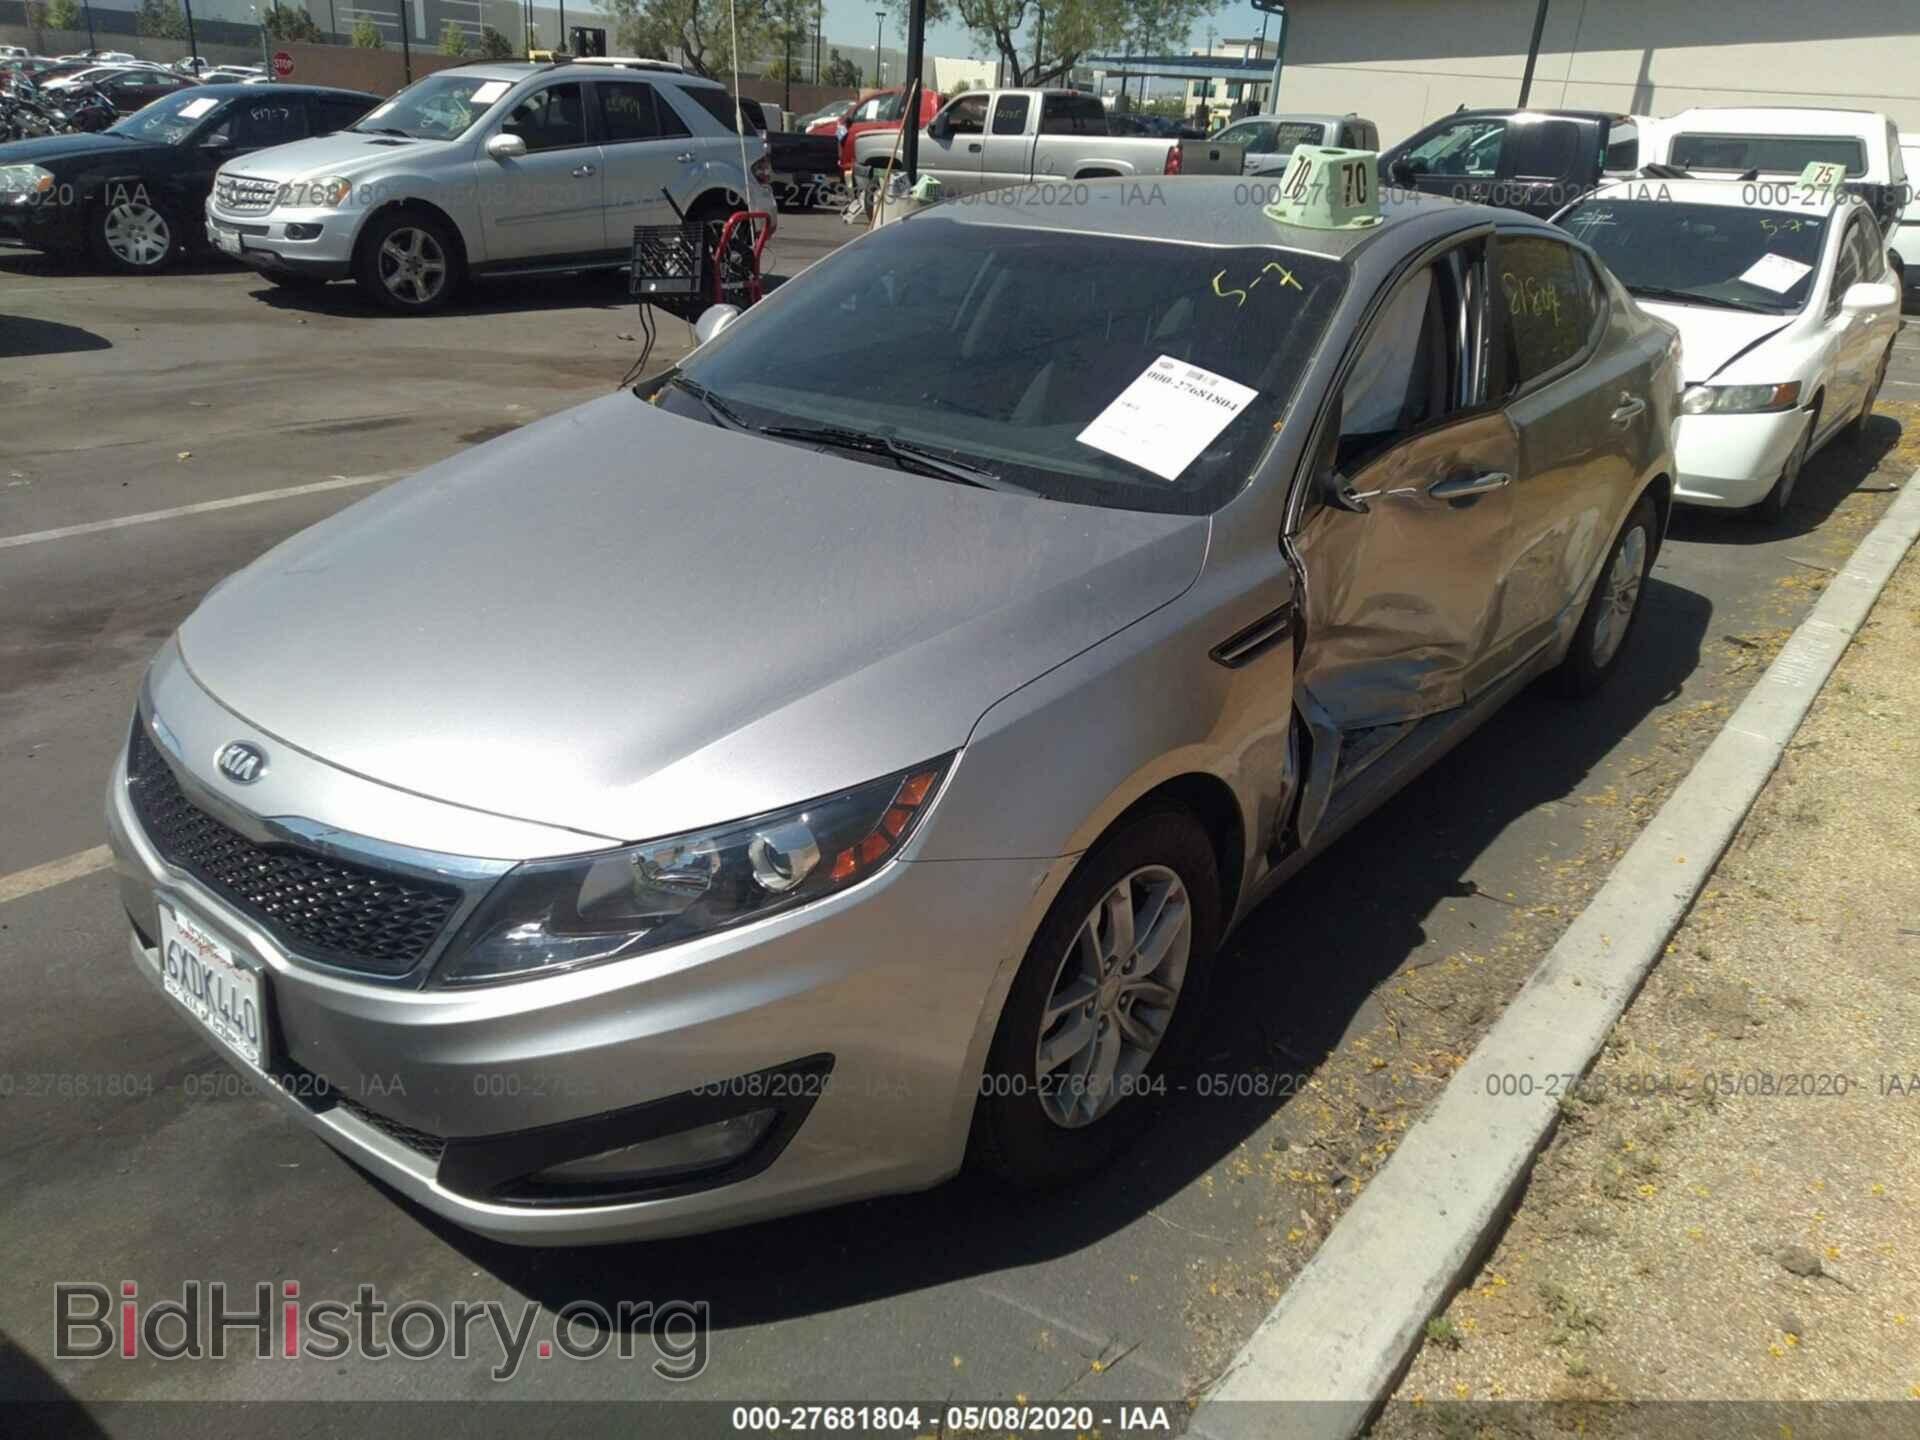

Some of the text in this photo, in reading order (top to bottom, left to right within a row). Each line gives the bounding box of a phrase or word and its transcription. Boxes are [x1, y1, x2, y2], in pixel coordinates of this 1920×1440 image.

[1284, 156, 1312, 200] 70
[1342, 162, 1367, 207] 70
[1814, 166, 1835, 184] 75
[167, 939, 258, 1045] 6XDK440
